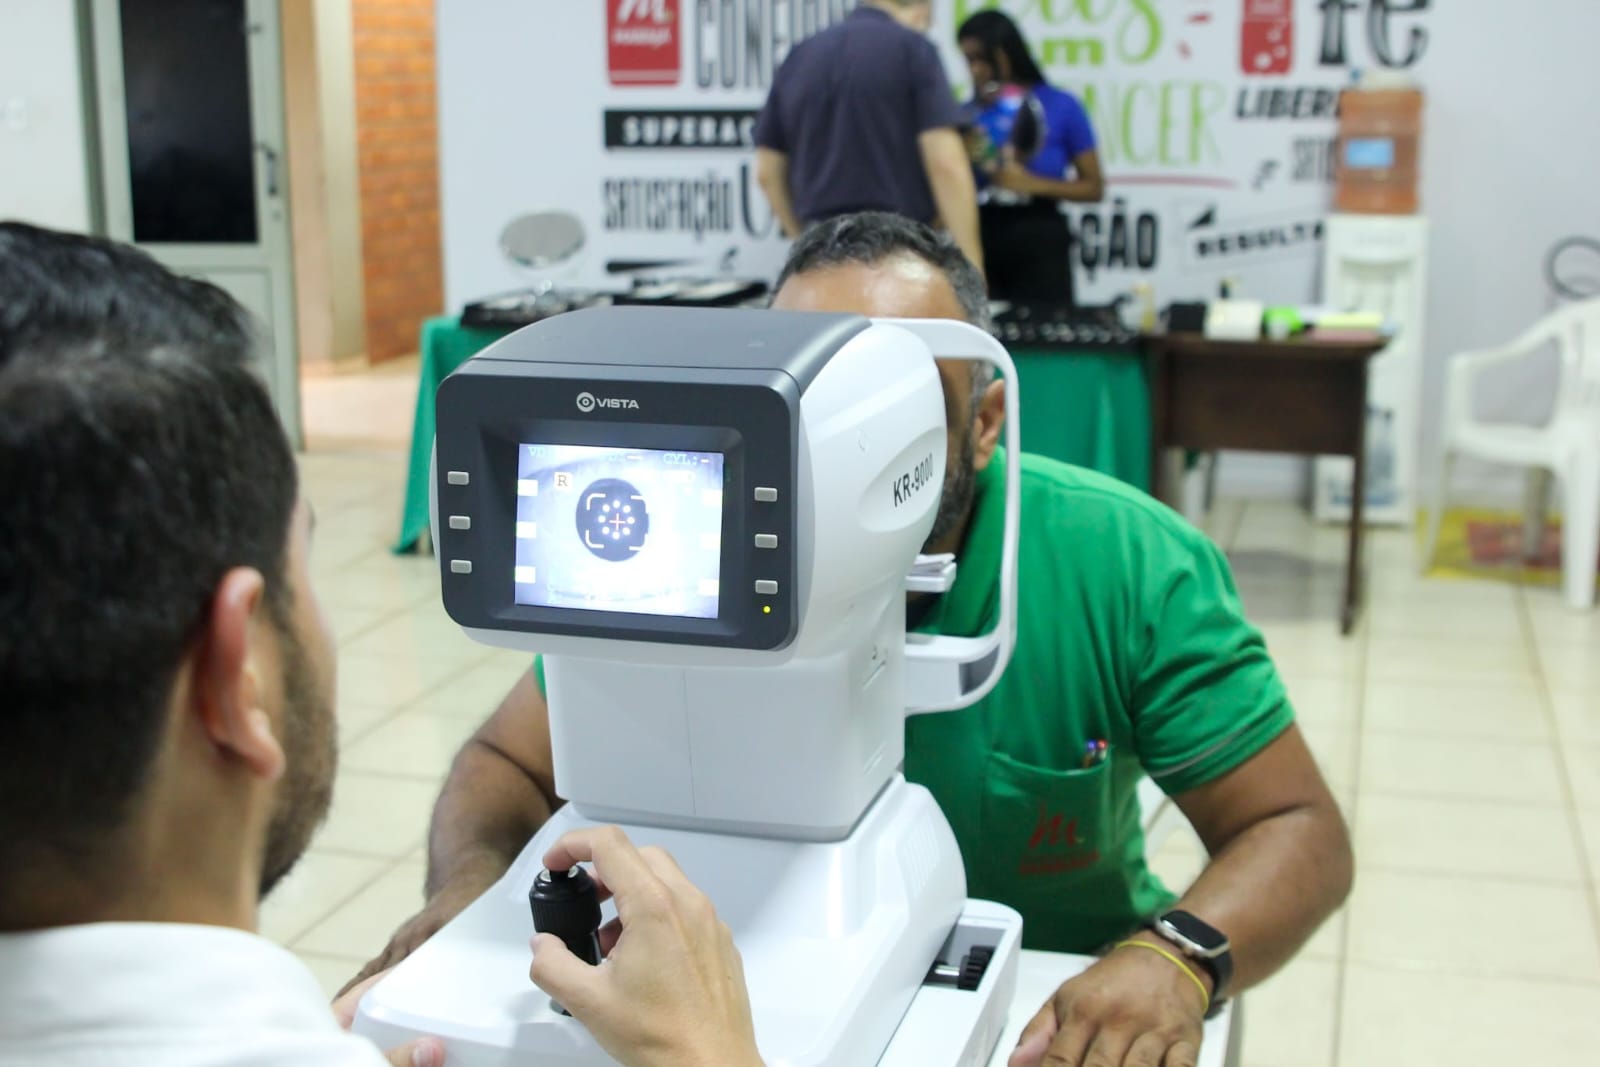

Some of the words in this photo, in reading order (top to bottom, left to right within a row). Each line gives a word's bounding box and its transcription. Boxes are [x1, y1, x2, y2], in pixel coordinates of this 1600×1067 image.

[596, 398, 640, 409] VISTA
[556, 474, 569, 487] R
[893, 451, 934, 508] KR-9000
